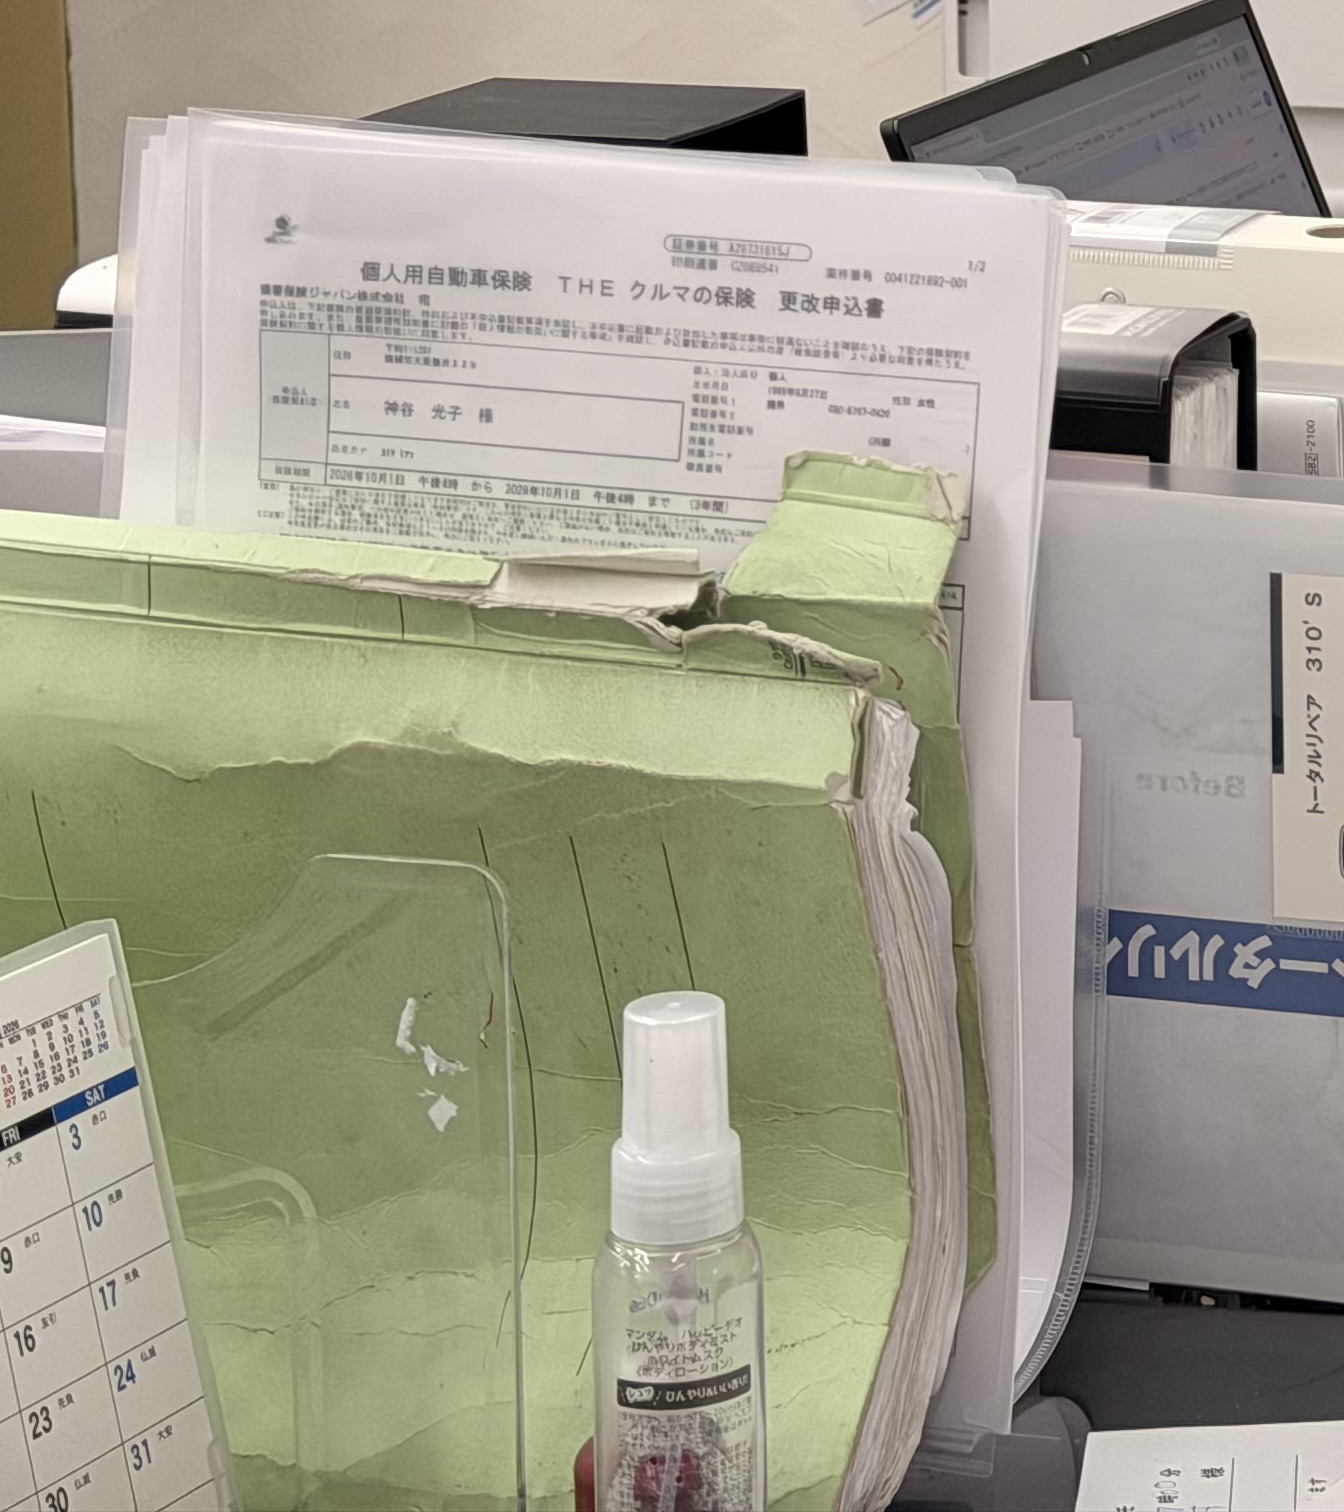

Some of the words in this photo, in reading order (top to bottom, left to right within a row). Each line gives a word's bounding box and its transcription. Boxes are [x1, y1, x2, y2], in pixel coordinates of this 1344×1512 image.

[360, 261, 533, 293] 個人用自動車保険
[558, 276, 615, 298] THE
[629, 279, 756, 310] クルマの保険
[778, 290, 886, 319] 更改申込書
[431, 403, 462, 423] 光子
[1305, 693, 1325, 815] トータルリペア
[85, 1084, 105, 1107] SAT
[69, 1123, 82, 1150] 3
[82, 1200, 103, 1232] 10
[0, 1246, 13, 1274] 9
[99, 1279, 117, 1311] 17
[14, 1325, 36, 1357] 16
[114, 1358, 136, 1392] 24
[28, 1406, 52, 1440] 23
[131, 1439, 151, 1471] 31
